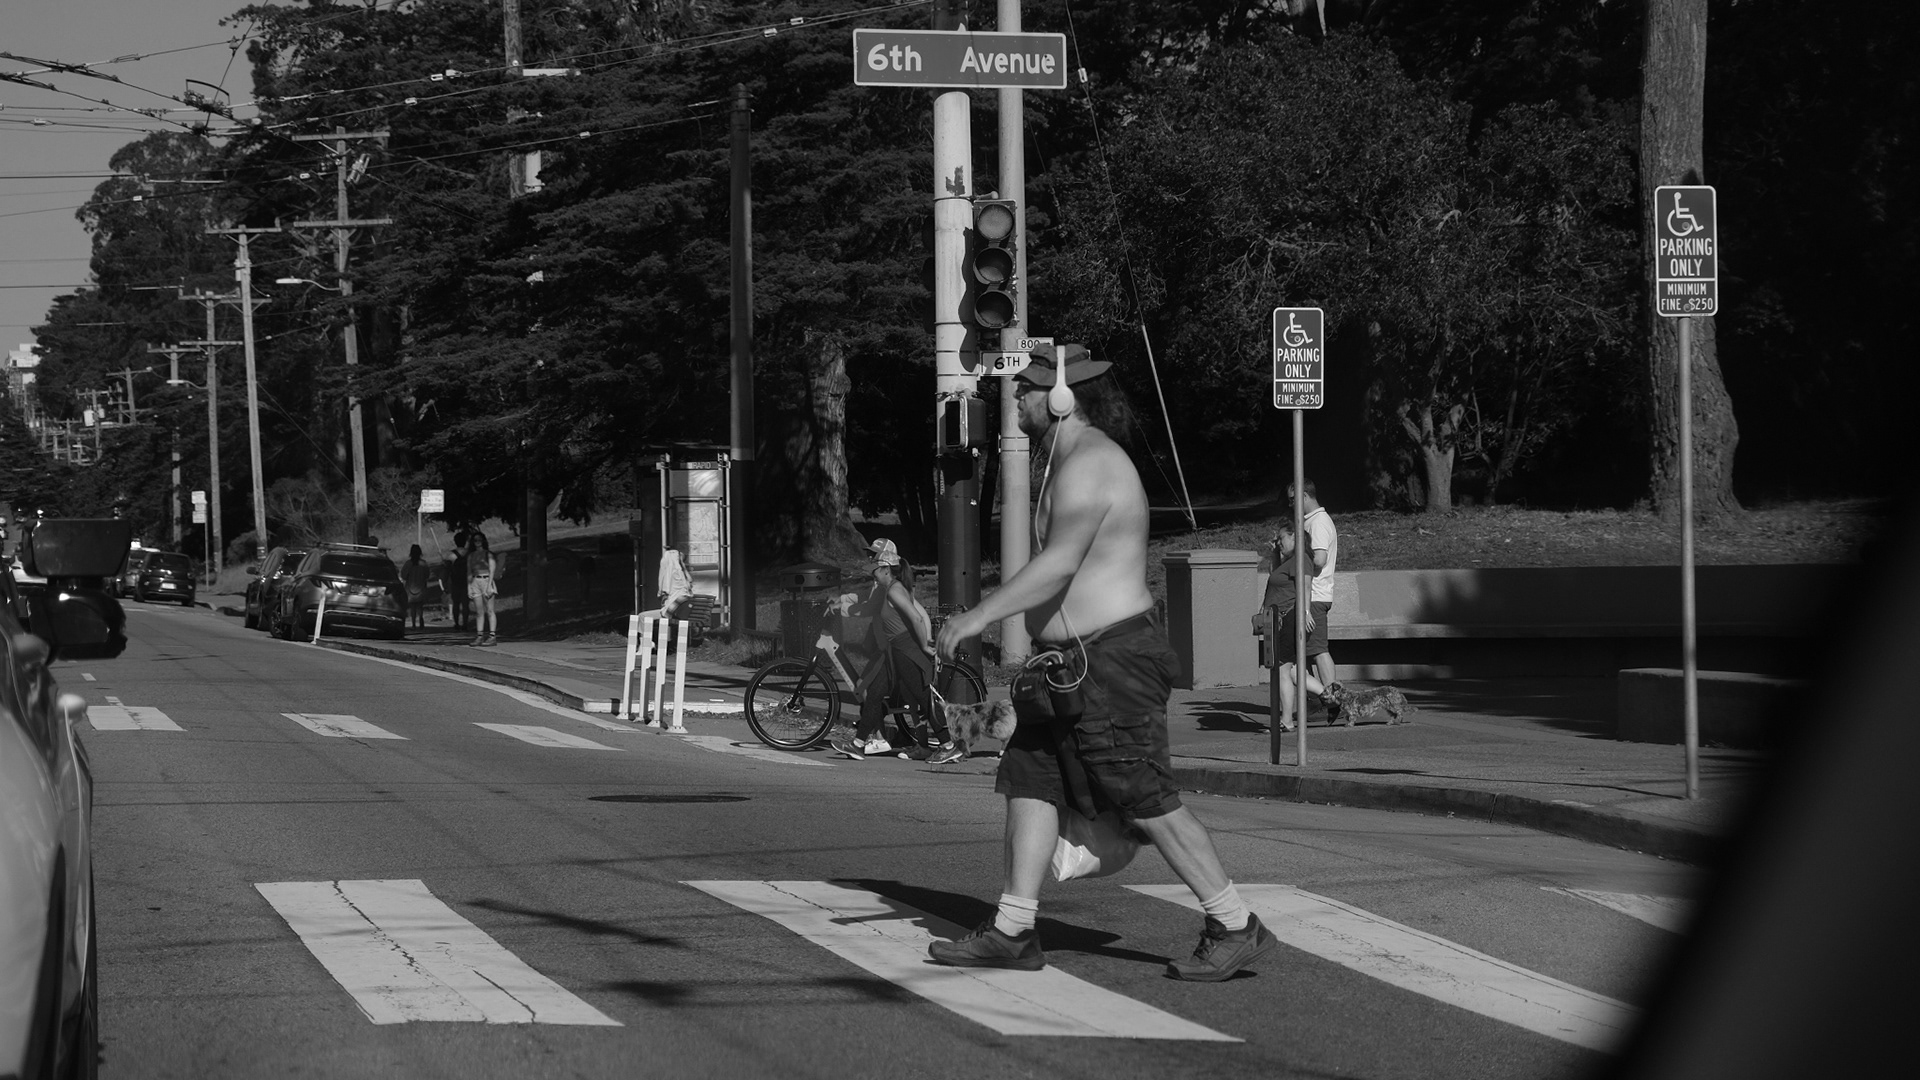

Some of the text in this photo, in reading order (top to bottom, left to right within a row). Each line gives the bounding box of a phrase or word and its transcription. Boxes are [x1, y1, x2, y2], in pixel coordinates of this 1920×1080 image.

[867, 43, 1055, 75] 6th Avenue
[1660, 238, 1713, 256] PARKING
[1670, 258, 1703, 277] ONLY
[1667, 283, 1707, 296] MINIMUM
[1661, 297, 1714, 311] FINE $250
[1277, 347, 1320, 362] PARKING
[994, 356, 1020, 370] 6TH
[1285, 363, 1312, 378] ONLY
[1282, 383, 1315, 393] MINIMUM
[1277, 394, 1320, 405] FINE $250
